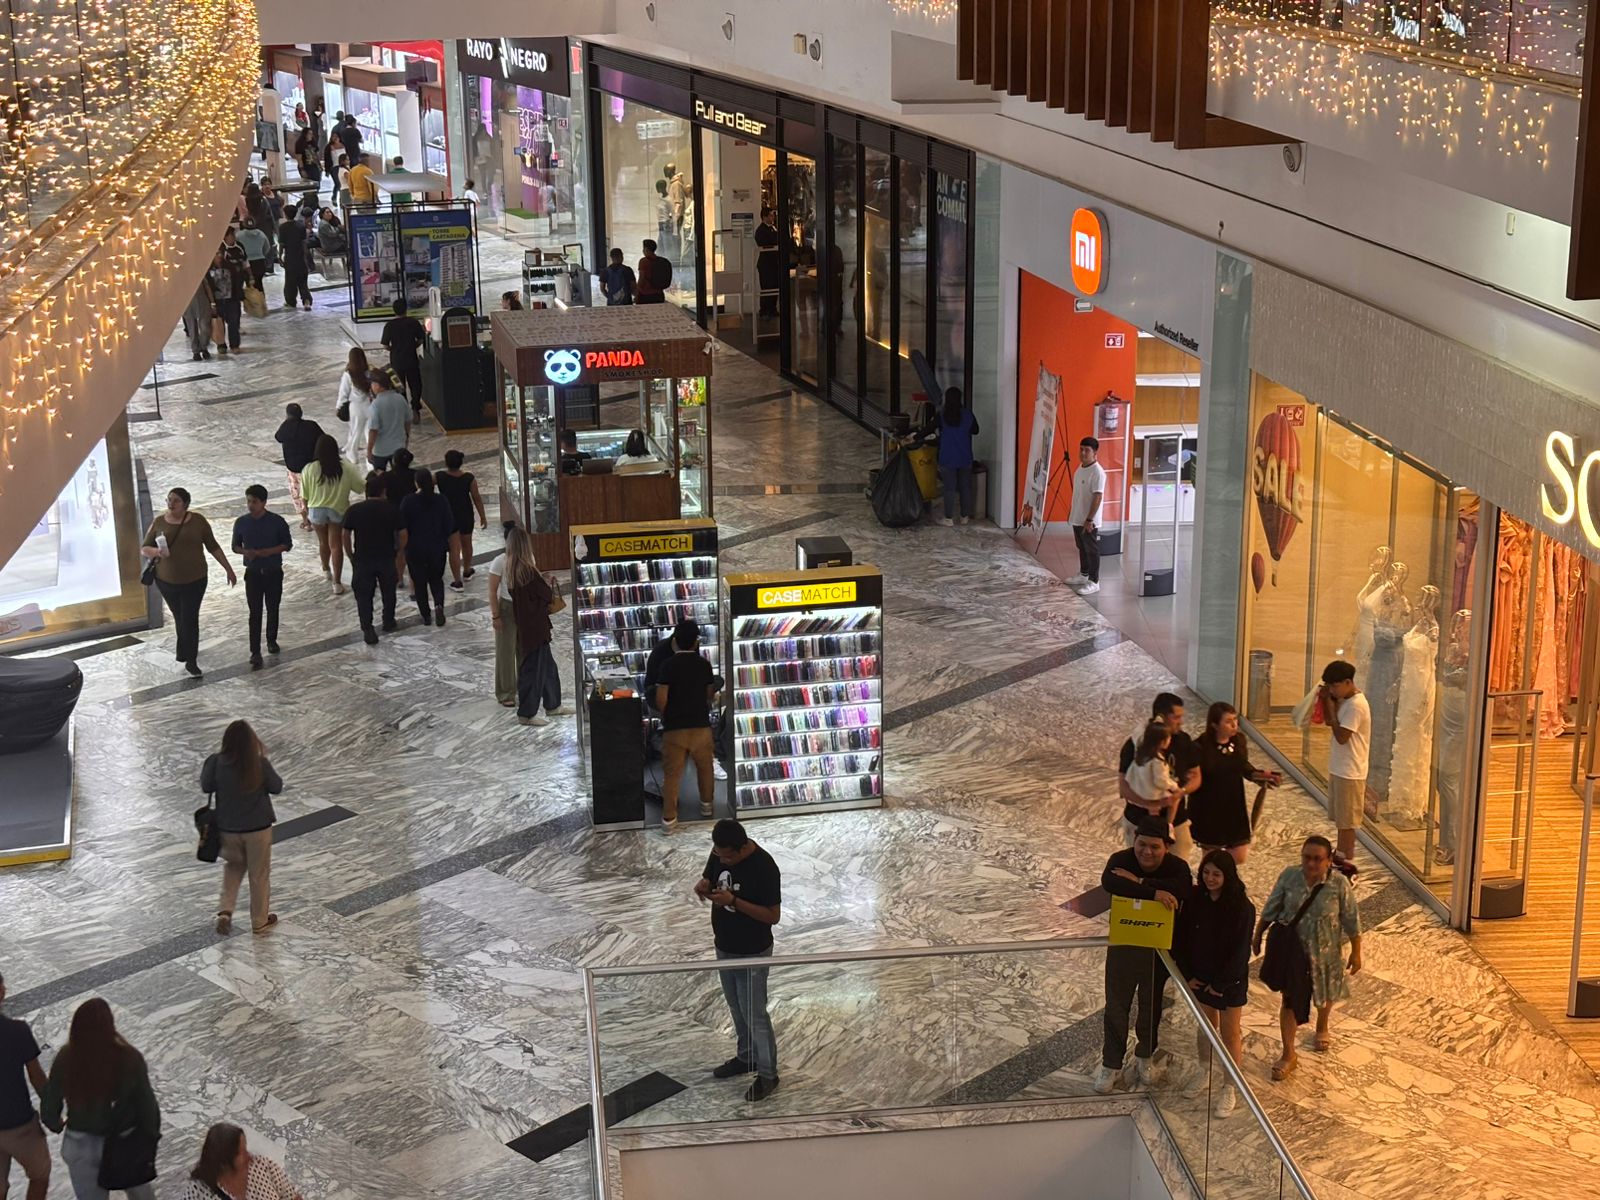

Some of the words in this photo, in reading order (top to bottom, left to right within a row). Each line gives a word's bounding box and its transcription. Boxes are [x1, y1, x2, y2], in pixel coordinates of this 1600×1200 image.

[466, 38, 493, 60] RAYO
[510, 47, 547, 73] NEGRO
[695, 100, 714, 120] Pull
[715, 110, 734, 127] and
[736, 112, 767, 135] Bear
[585, 350, 645, 368] PANDA
[1253, 446, 1304, 523] SALE
[604, 536, 689, 553] CASEMATCH
[762, 586, 851, 604] CASEMATCH
[1119, 918, 1165, 928] SHAFT
